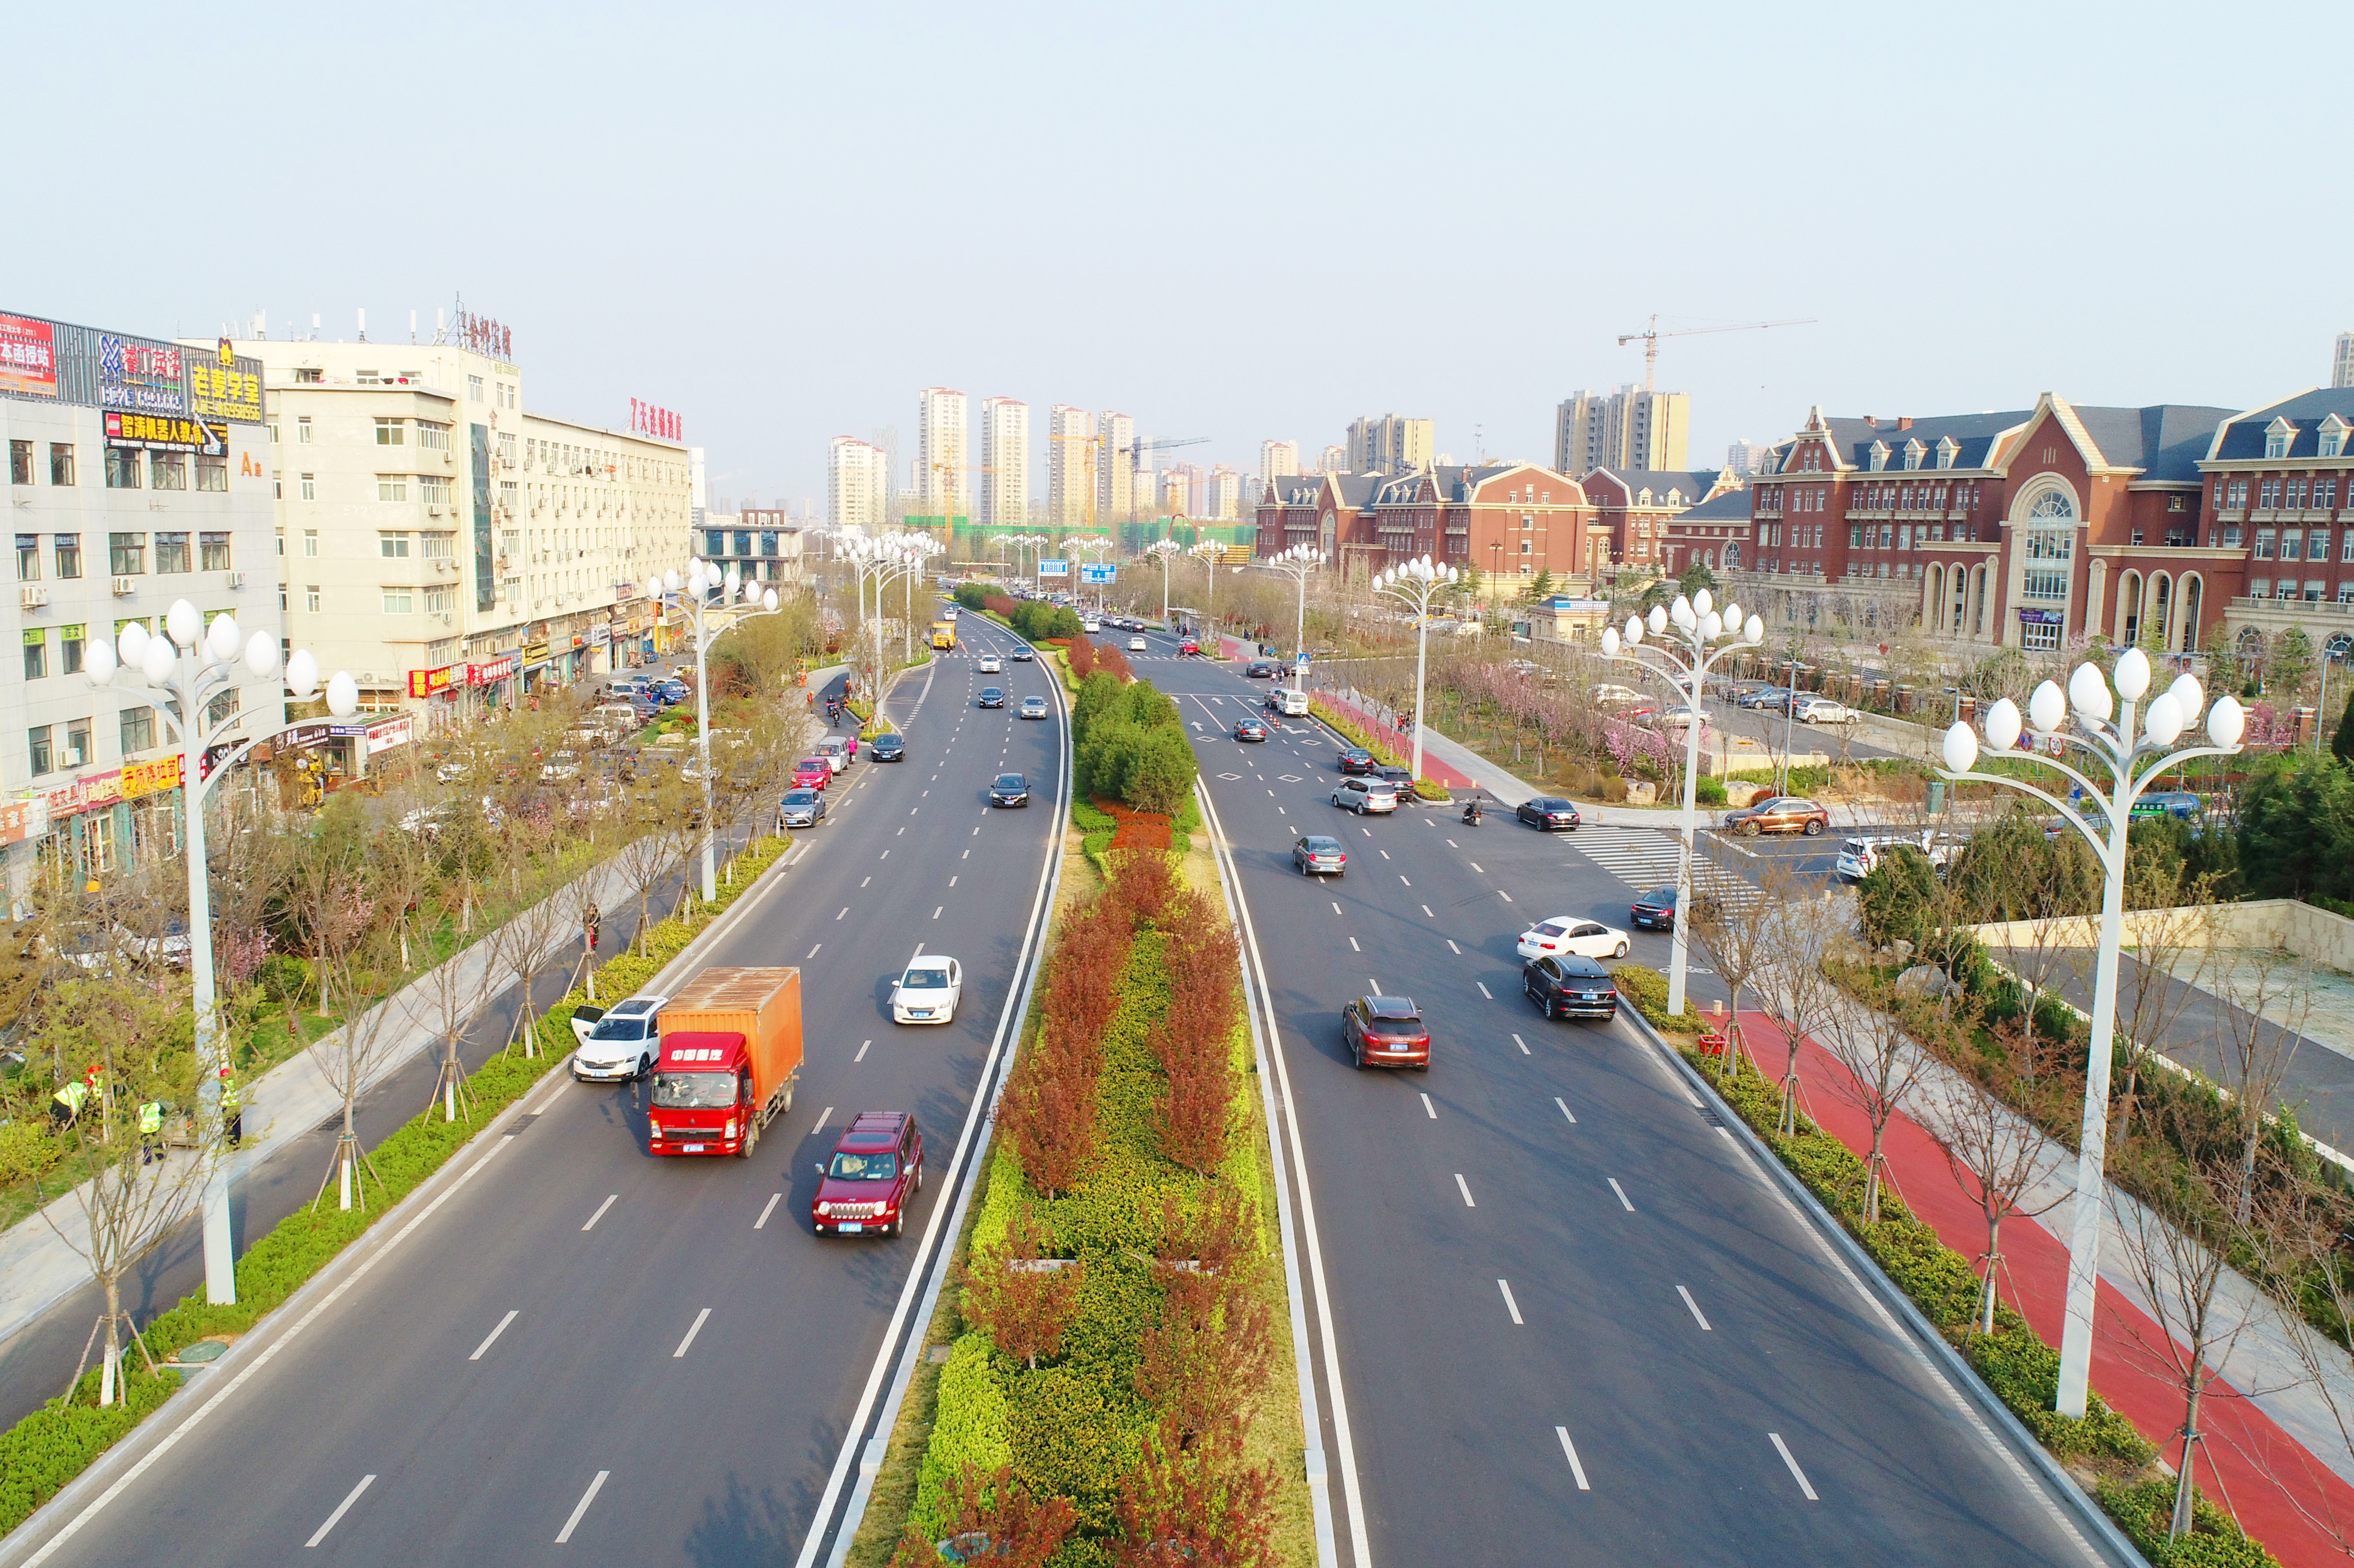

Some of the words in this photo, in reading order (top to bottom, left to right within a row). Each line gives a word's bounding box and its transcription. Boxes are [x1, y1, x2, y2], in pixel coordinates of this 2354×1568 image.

[0, 340, 49, 367] 本函授站
[194, 365, 259, 403] 老麦学堂
[121, 414, 203, 445] 智涛机器人教育
[631, 397, 682, 442] 7天连锁酒店
[413, 672, 425, 696] 面馆
[2052, 740, 2061, 751] 30
[671, 1049, 724, 1061] 中国重汽
